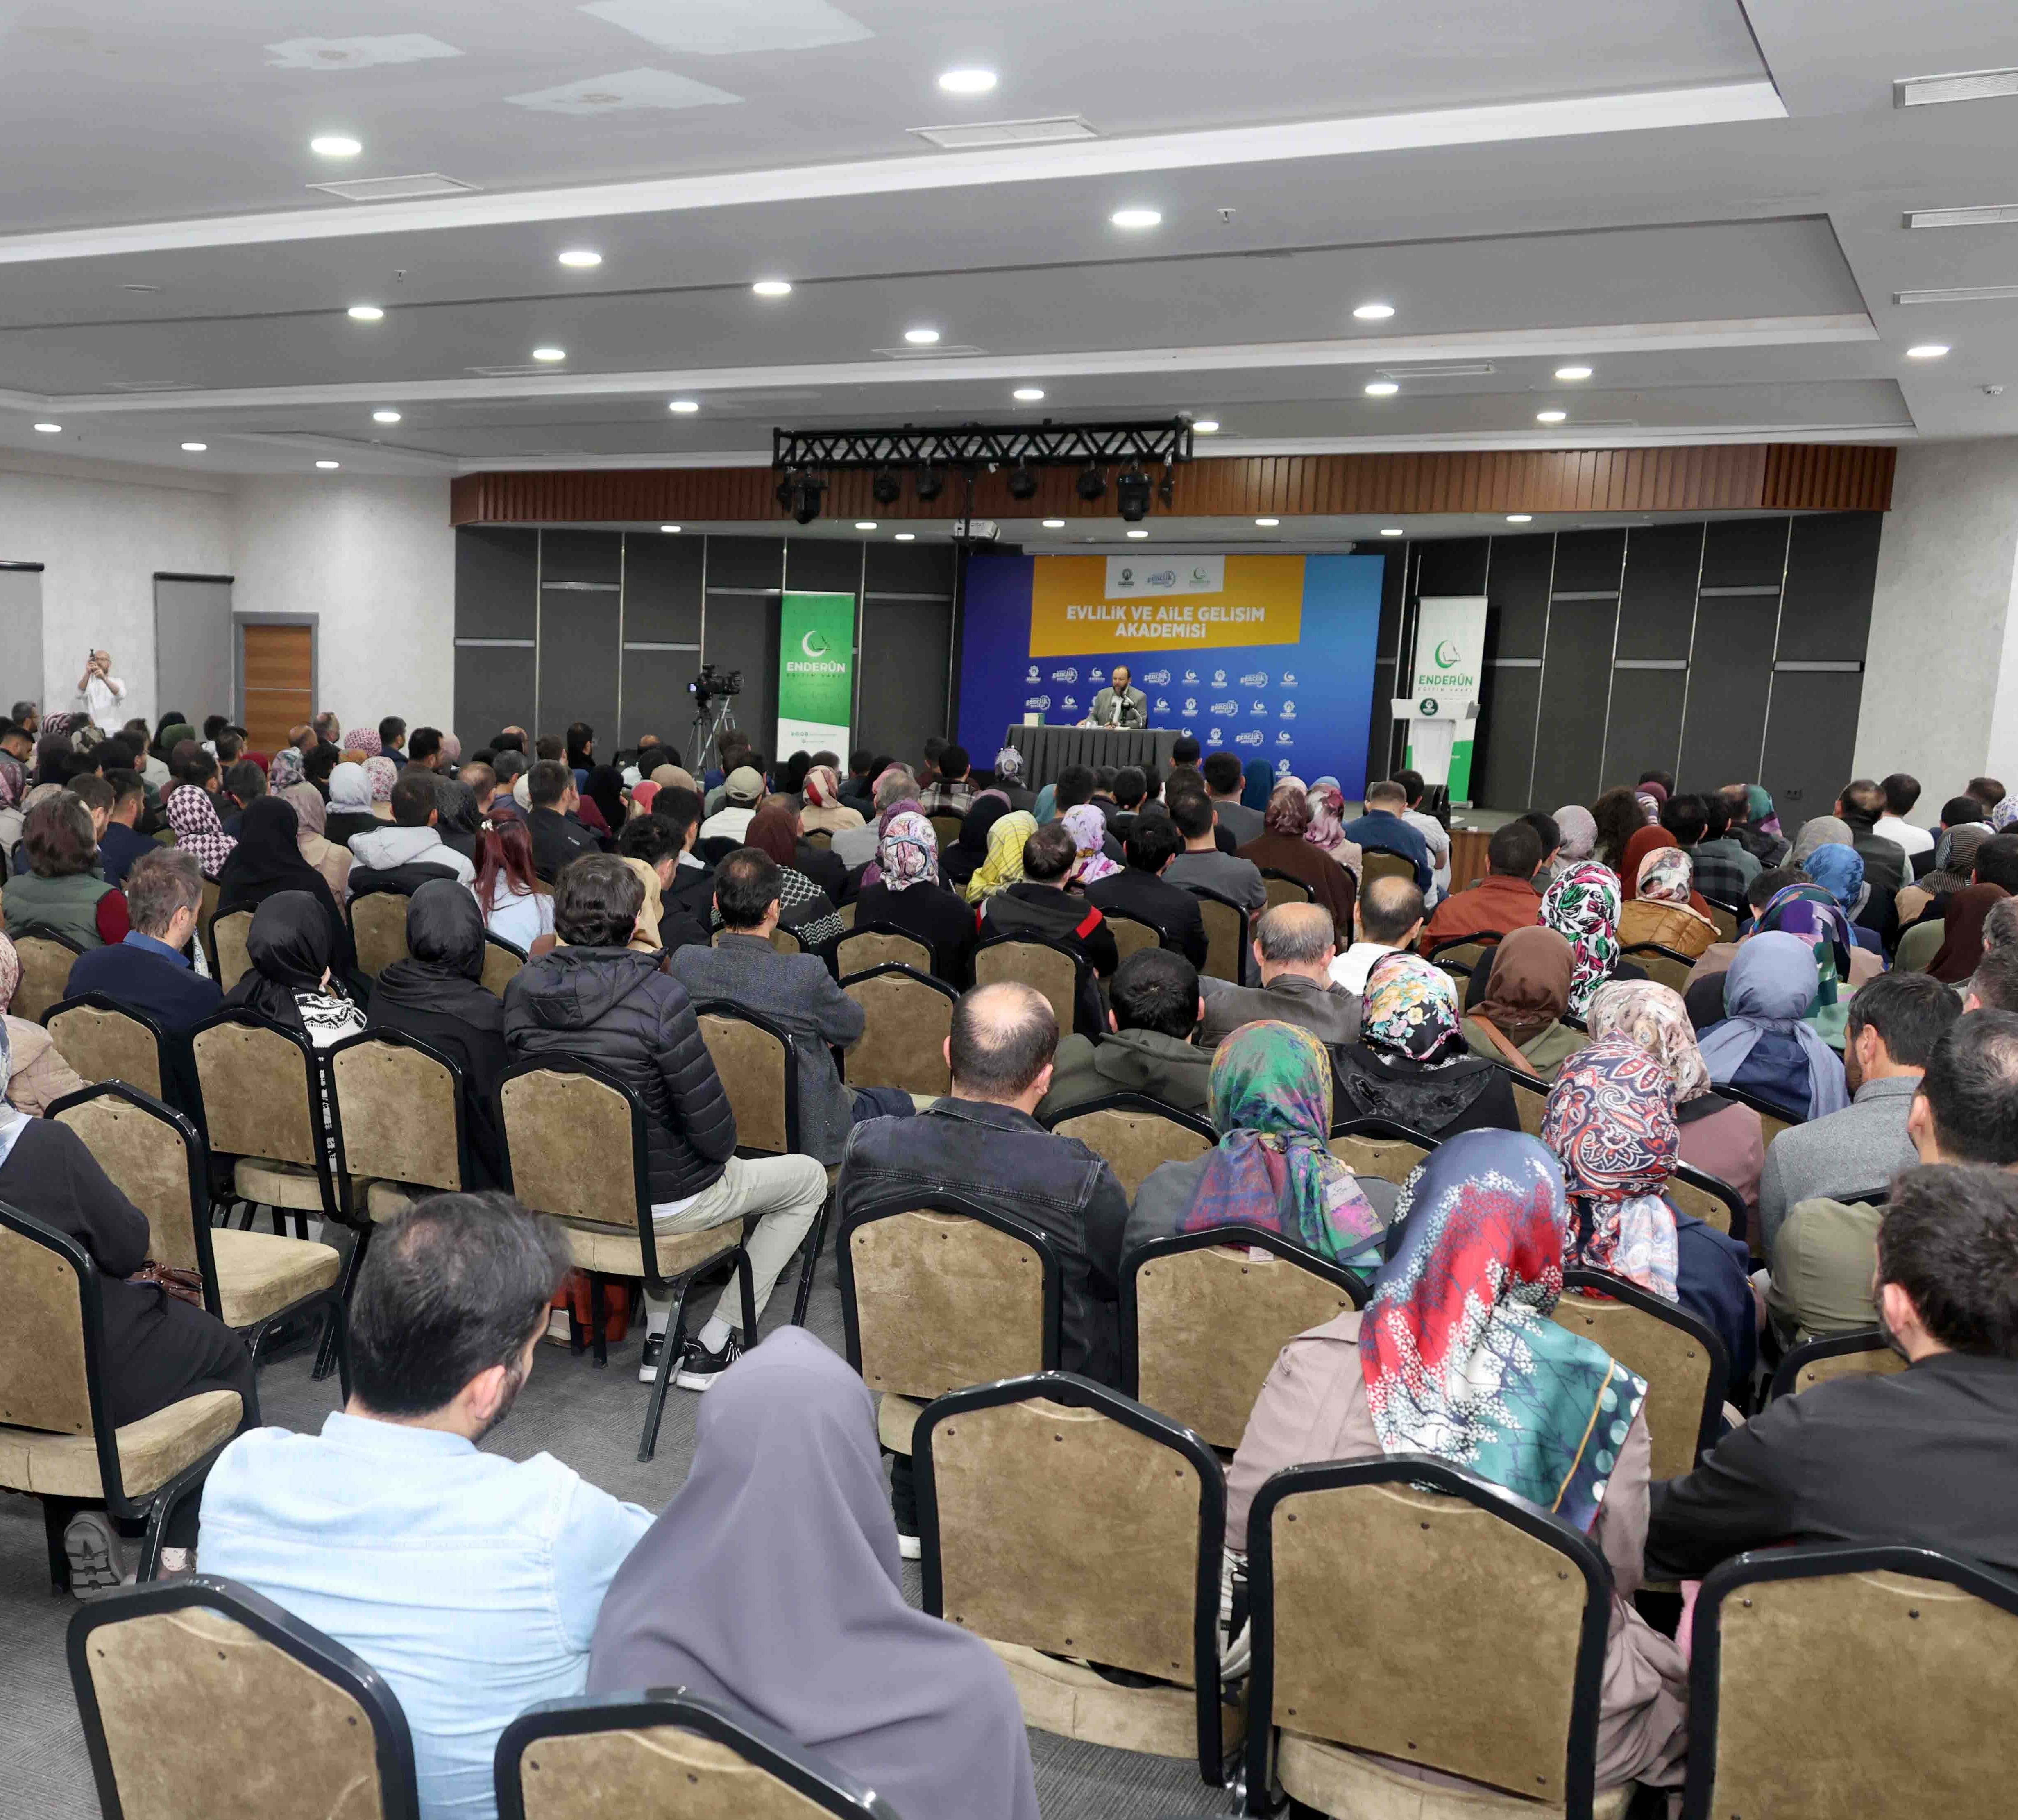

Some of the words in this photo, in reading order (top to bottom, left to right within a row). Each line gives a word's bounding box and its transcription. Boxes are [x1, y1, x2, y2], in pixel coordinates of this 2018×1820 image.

[1131, 605, 1153, 620] VE
[787, 660, 846, 672] ENDERÛN
[1419, 673, 1473, 686] ENDERÛN
